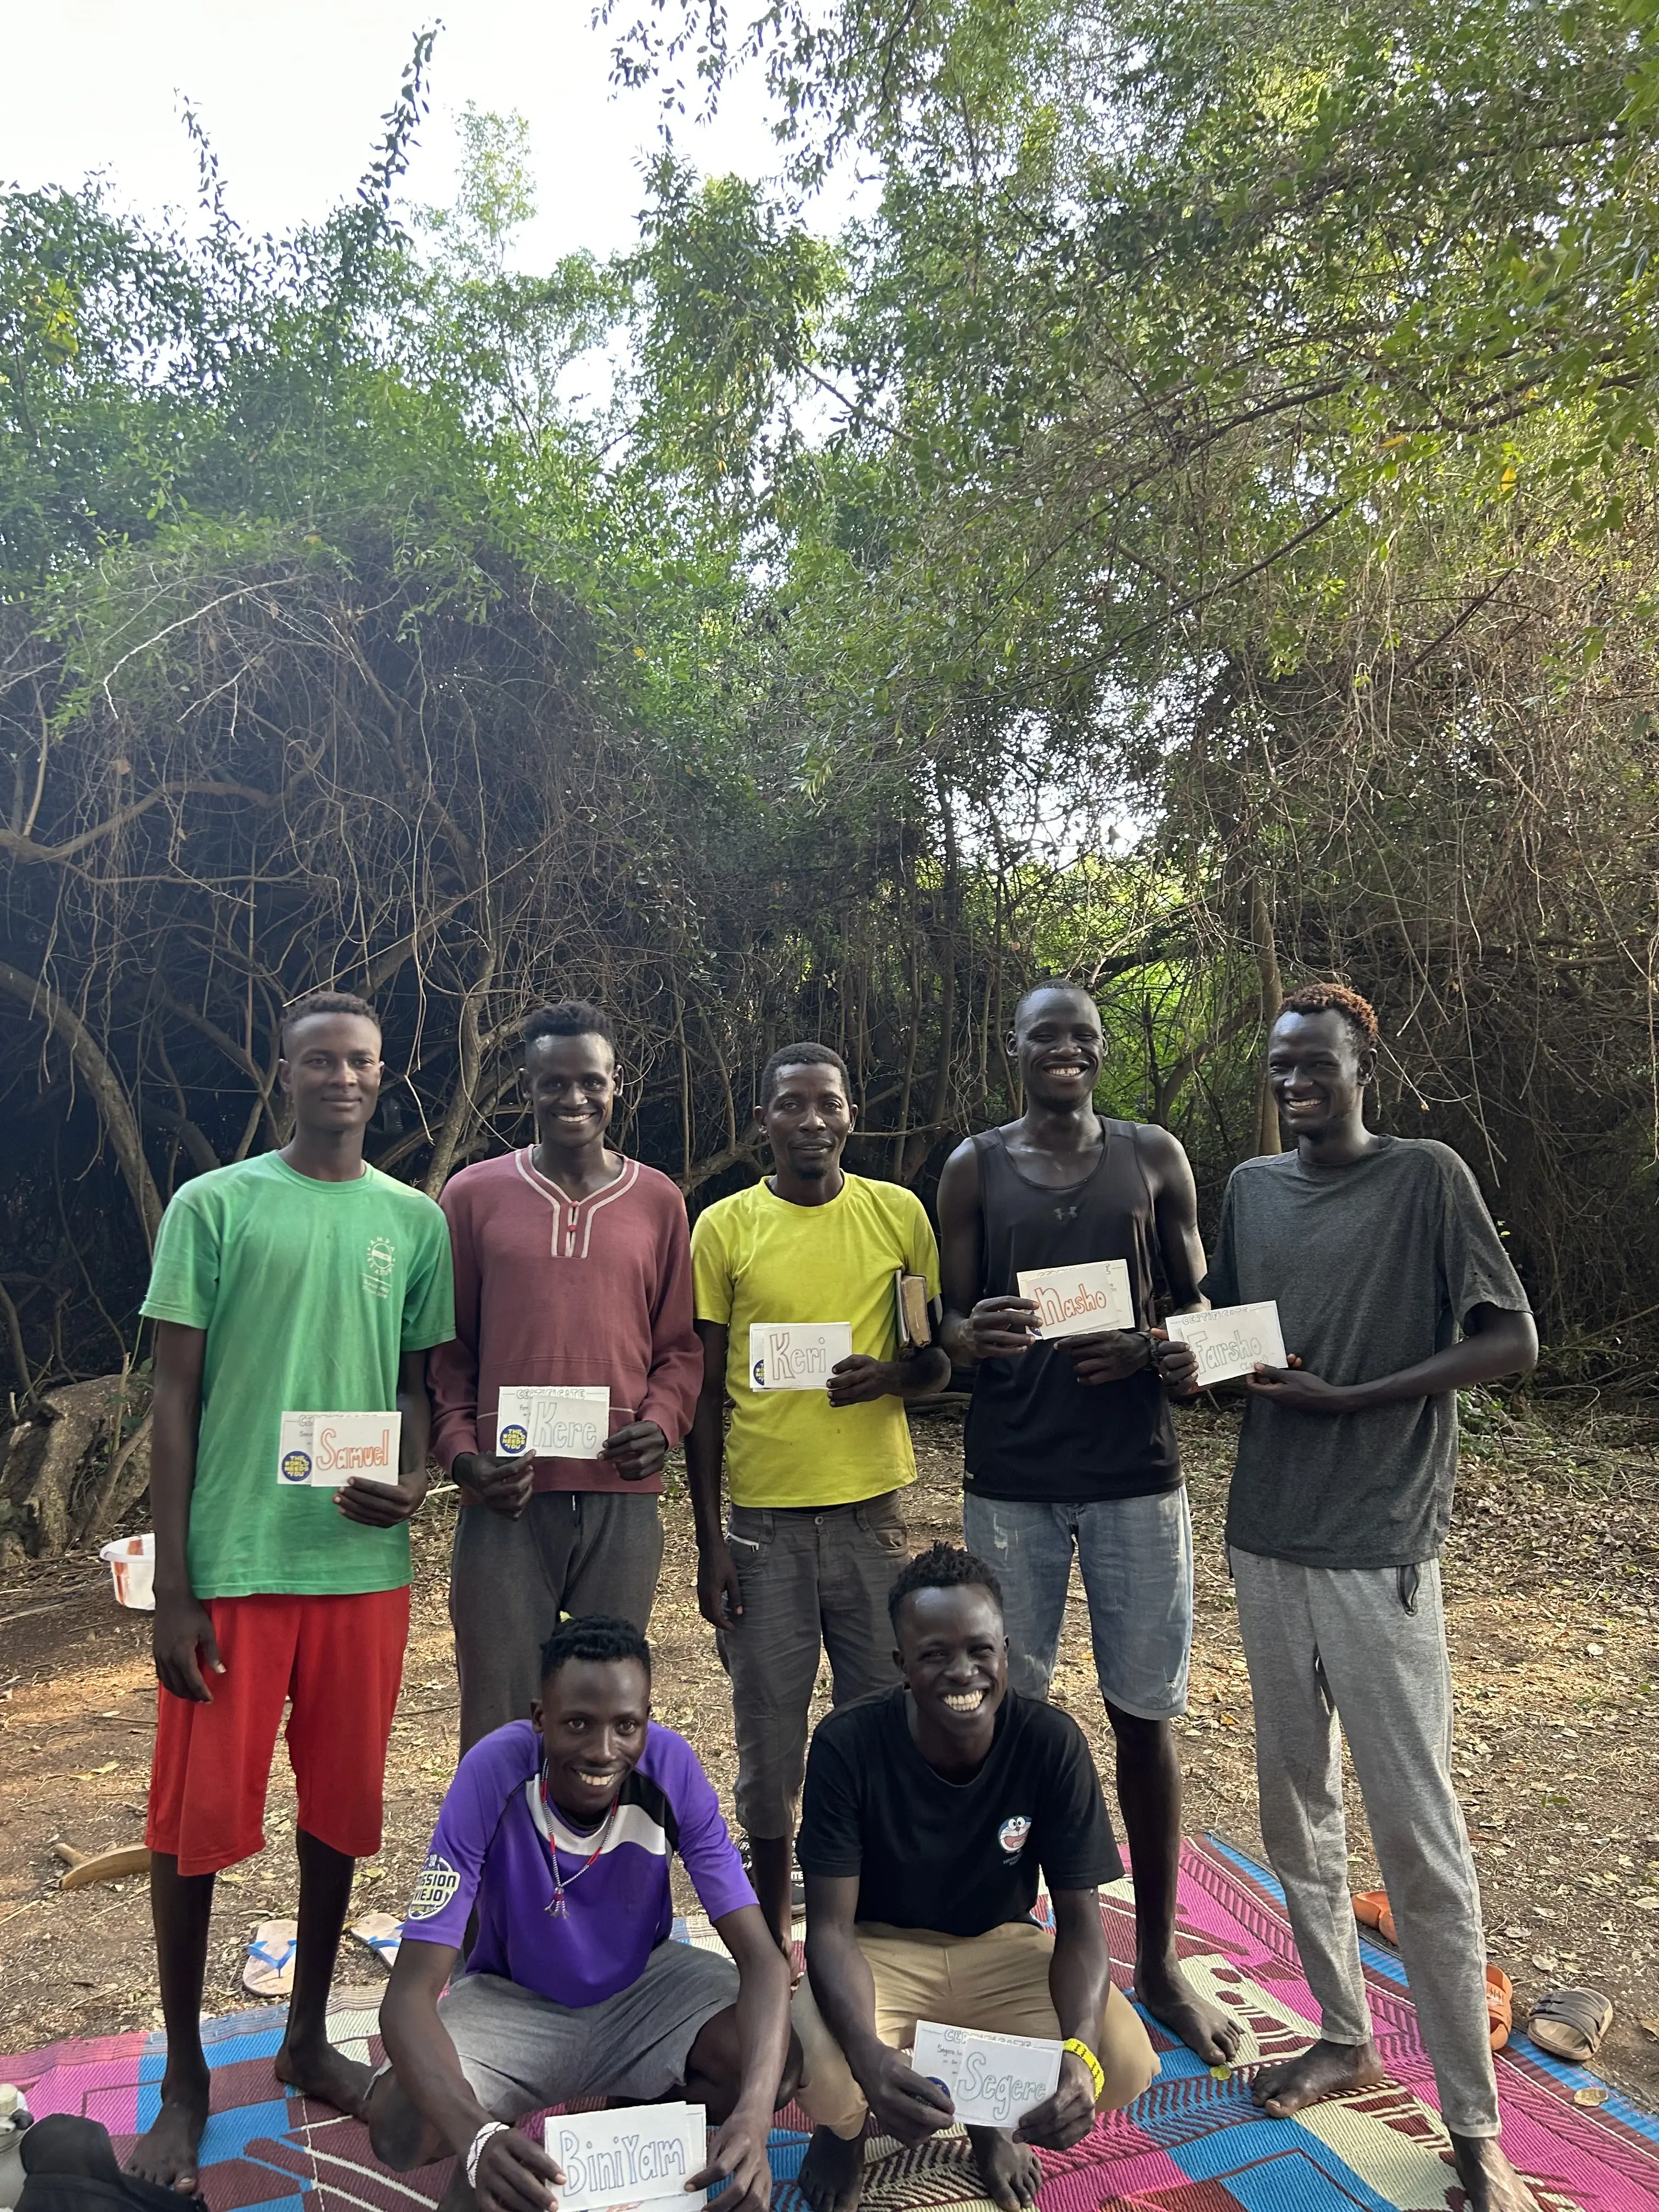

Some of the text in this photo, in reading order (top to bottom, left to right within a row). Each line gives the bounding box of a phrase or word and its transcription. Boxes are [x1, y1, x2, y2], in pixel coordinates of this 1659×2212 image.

[770, 1332, 826, 1380] Keri
[1187, 1330, 1262, 1375] Farsho
[316, 1428, 391, 1471] Samuel
[532, 1402, 597, 1450] Kere
[957, 2051, 1046, 2121] Segere
